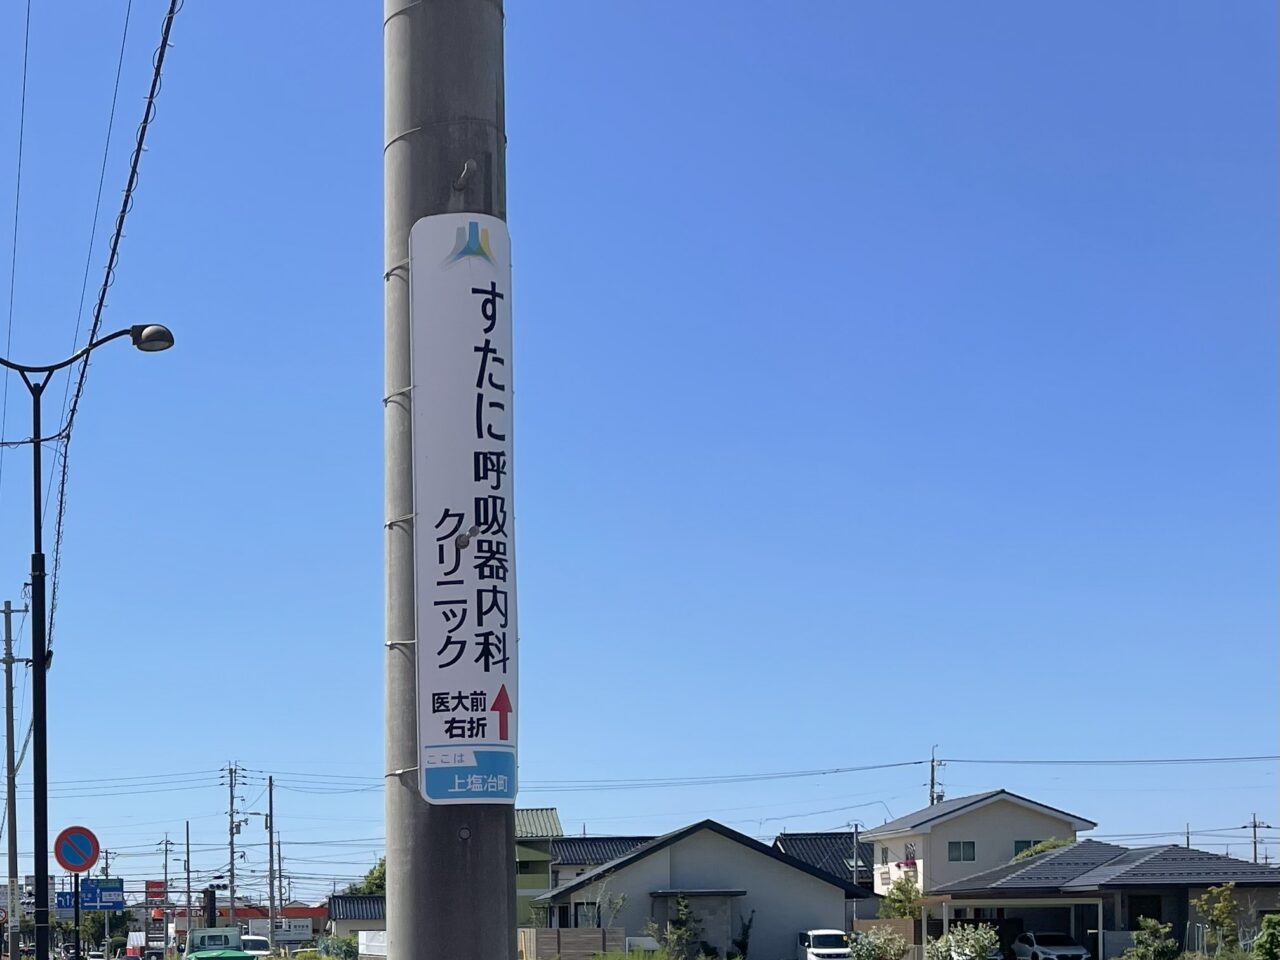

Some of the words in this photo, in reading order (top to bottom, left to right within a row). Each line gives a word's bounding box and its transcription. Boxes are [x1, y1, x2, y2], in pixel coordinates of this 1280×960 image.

[471, 280, 510, 674] すたに呼吸器内科
[433, 507, 468, 669] クリニック
[431, 690, 487, 713] 医大前
[444, 716, 488, 739] 右折
[426, 752, 465, 765] ここは
[447, 773, 508, 793] 上塩冶町
